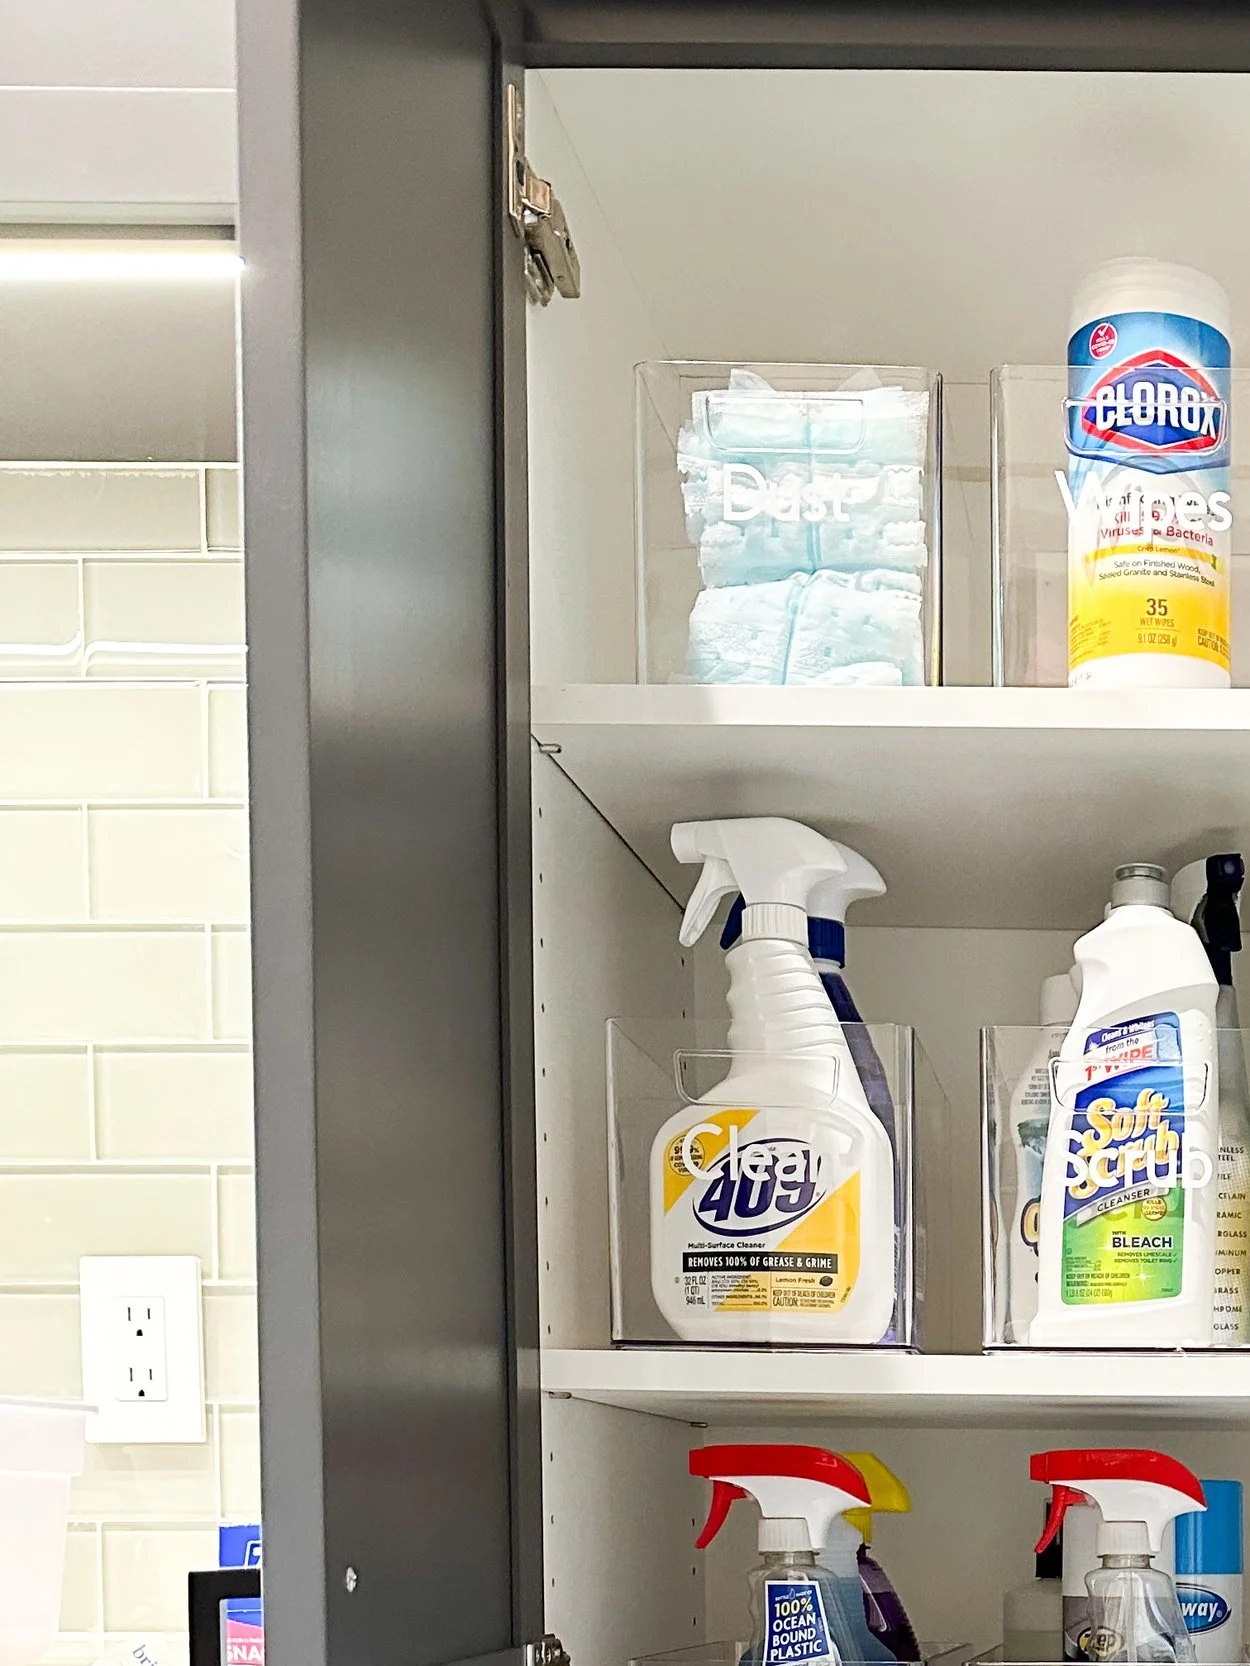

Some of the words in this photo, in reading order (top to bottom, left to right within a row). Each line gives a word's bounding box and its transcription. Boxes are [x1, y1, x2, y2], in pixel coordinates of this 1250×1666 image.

[1095, 381, 1217, 440] CLOROX
[724, 463, 849, 521] Dust
[1054, 470, 1233, 546] Wipes
[1101, 527, 1145, 540] Viruses
[1166, 526, 1214, 547] Bacteria
[1114, 560, 1130, 568] Safe
[1143, 560, 1176, 568] Finished
[1153, 568, 1168, 576] and
[1146, 598, 1168, 616] 35
[1140, 617, 1154, 626] WET
[1155, 618, 1175, 628] WIPES
[1126, 1037, 1139, 1047] the
[1081, 1087, 1170, 1149] Soft
[1060, 1129, 1213, 1189] Scrub
[698, 1150, 817, 1222] 409
[1097, 1188, 1151, 1212] CLEANSER
[688, 1242, 735, 1250] Multi-Surface
[736, 1241, 766, 1249] Cleaner
[1112, 1236, 1173, 1248] BLEACH
[688, 1256, 723, 1268] REMOVES
[725, 1257, 747, 1267] 100%
[749, 1256, 760, 1267] OF
[763, 1256, 794, 1267] GREASE
[796, 1257, 803, 1268] &
[805, 1257, 833, 1269] GRIME
[798, 1276, 816, 1284] Fresh
[774, 1597, 813, 1618] 100%
[773, 1612, 817, 1632] OCEAN
[772, 1627, 816, 1647] BOUND
[770, 1639, 822, 1661] PLASTIC
